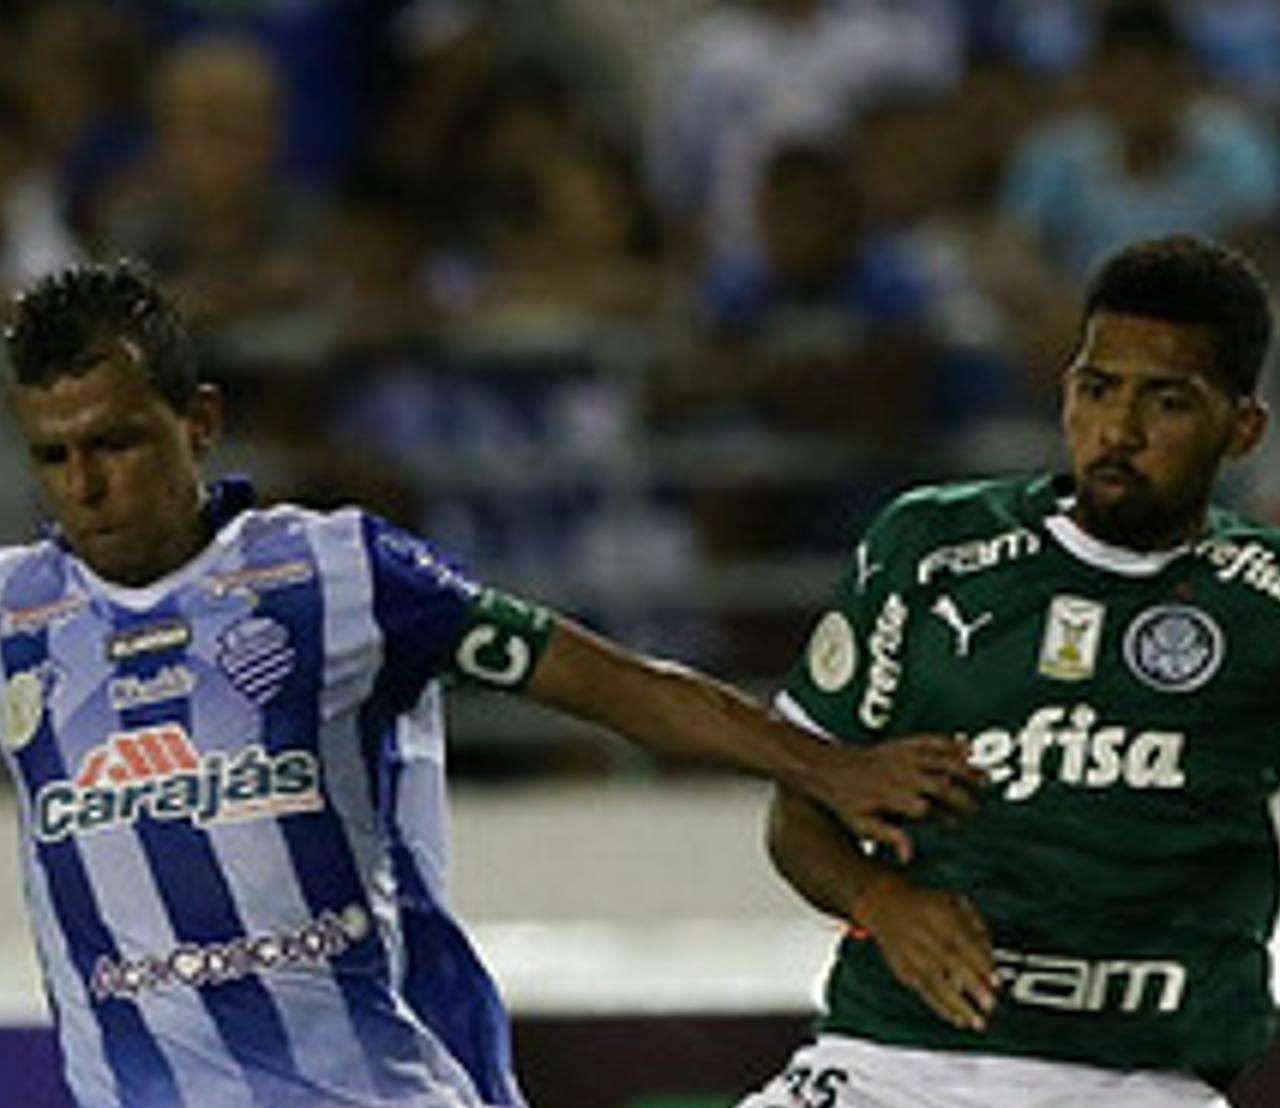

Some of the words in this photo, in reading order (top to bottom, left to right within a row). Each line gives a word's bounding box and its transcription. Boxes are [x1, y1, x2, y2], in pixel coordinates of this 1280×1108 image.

[454, 622, 531, 687] C
[36, 742, 322, 842] Carajás
[958, 702, 1187, 800] efisa
